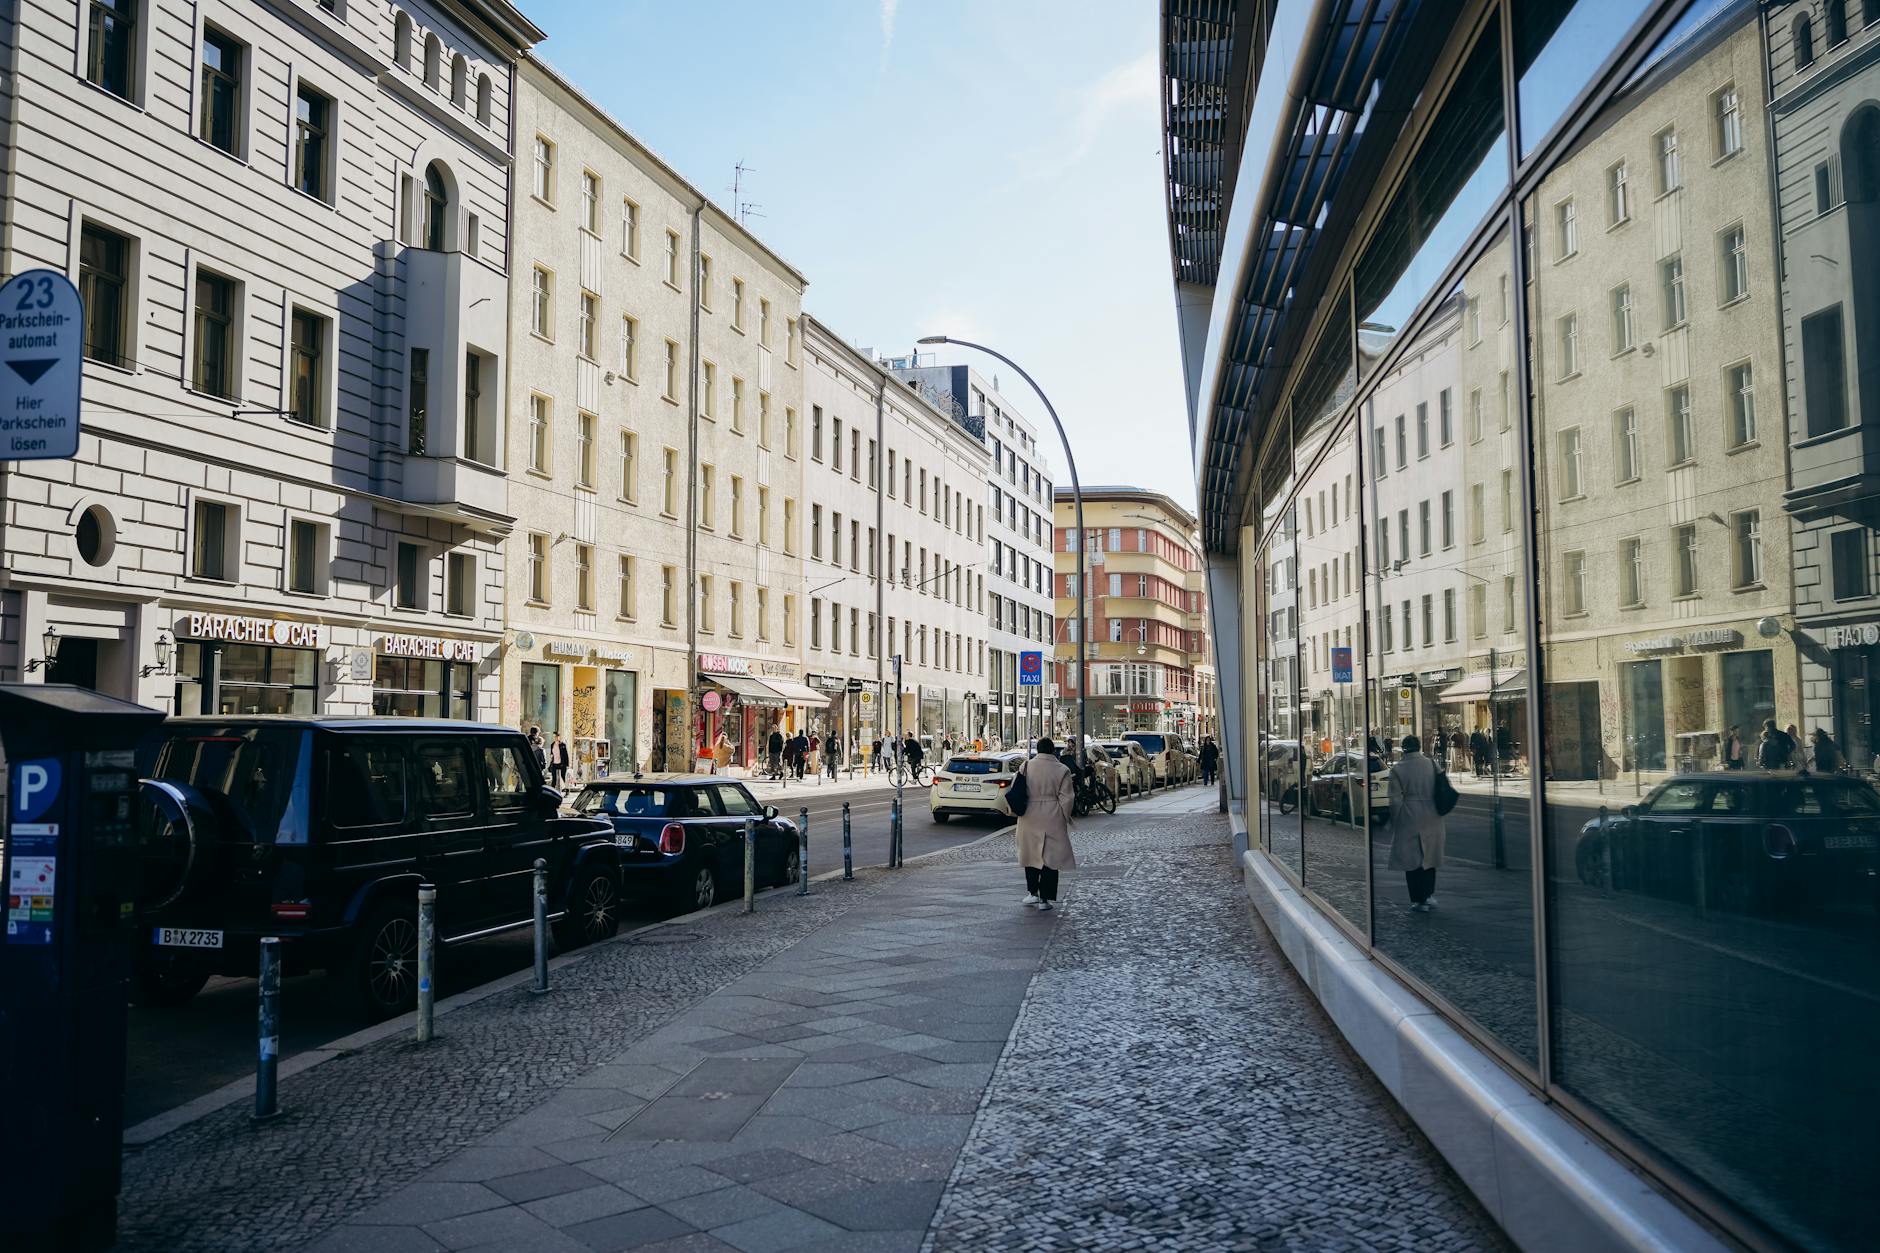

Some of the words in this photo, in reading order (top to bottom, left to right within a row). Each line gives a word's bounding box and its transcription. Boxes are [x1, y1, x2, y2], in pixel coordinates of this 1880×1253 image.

[16, 277, 54, 311] 23
[0, 311, 70, 329] Parkschein-
[9, 332, 57, 349] automat
[16, 396, 44, 411] Hier
[11, 436, 46, 451] lösen
[190, 614, 274, 644] BARACHEL
[384, 635, 443, 658] BARACHEL
[553, 641, 590, 656] HUMANA
[1021, 674, 1040, 683] TAXI
[20, 765, 48, 811] P
[164, 930, 172, 943] B
[180, 930, 187, 945] X
[189, 931, 219, 945] 2735
